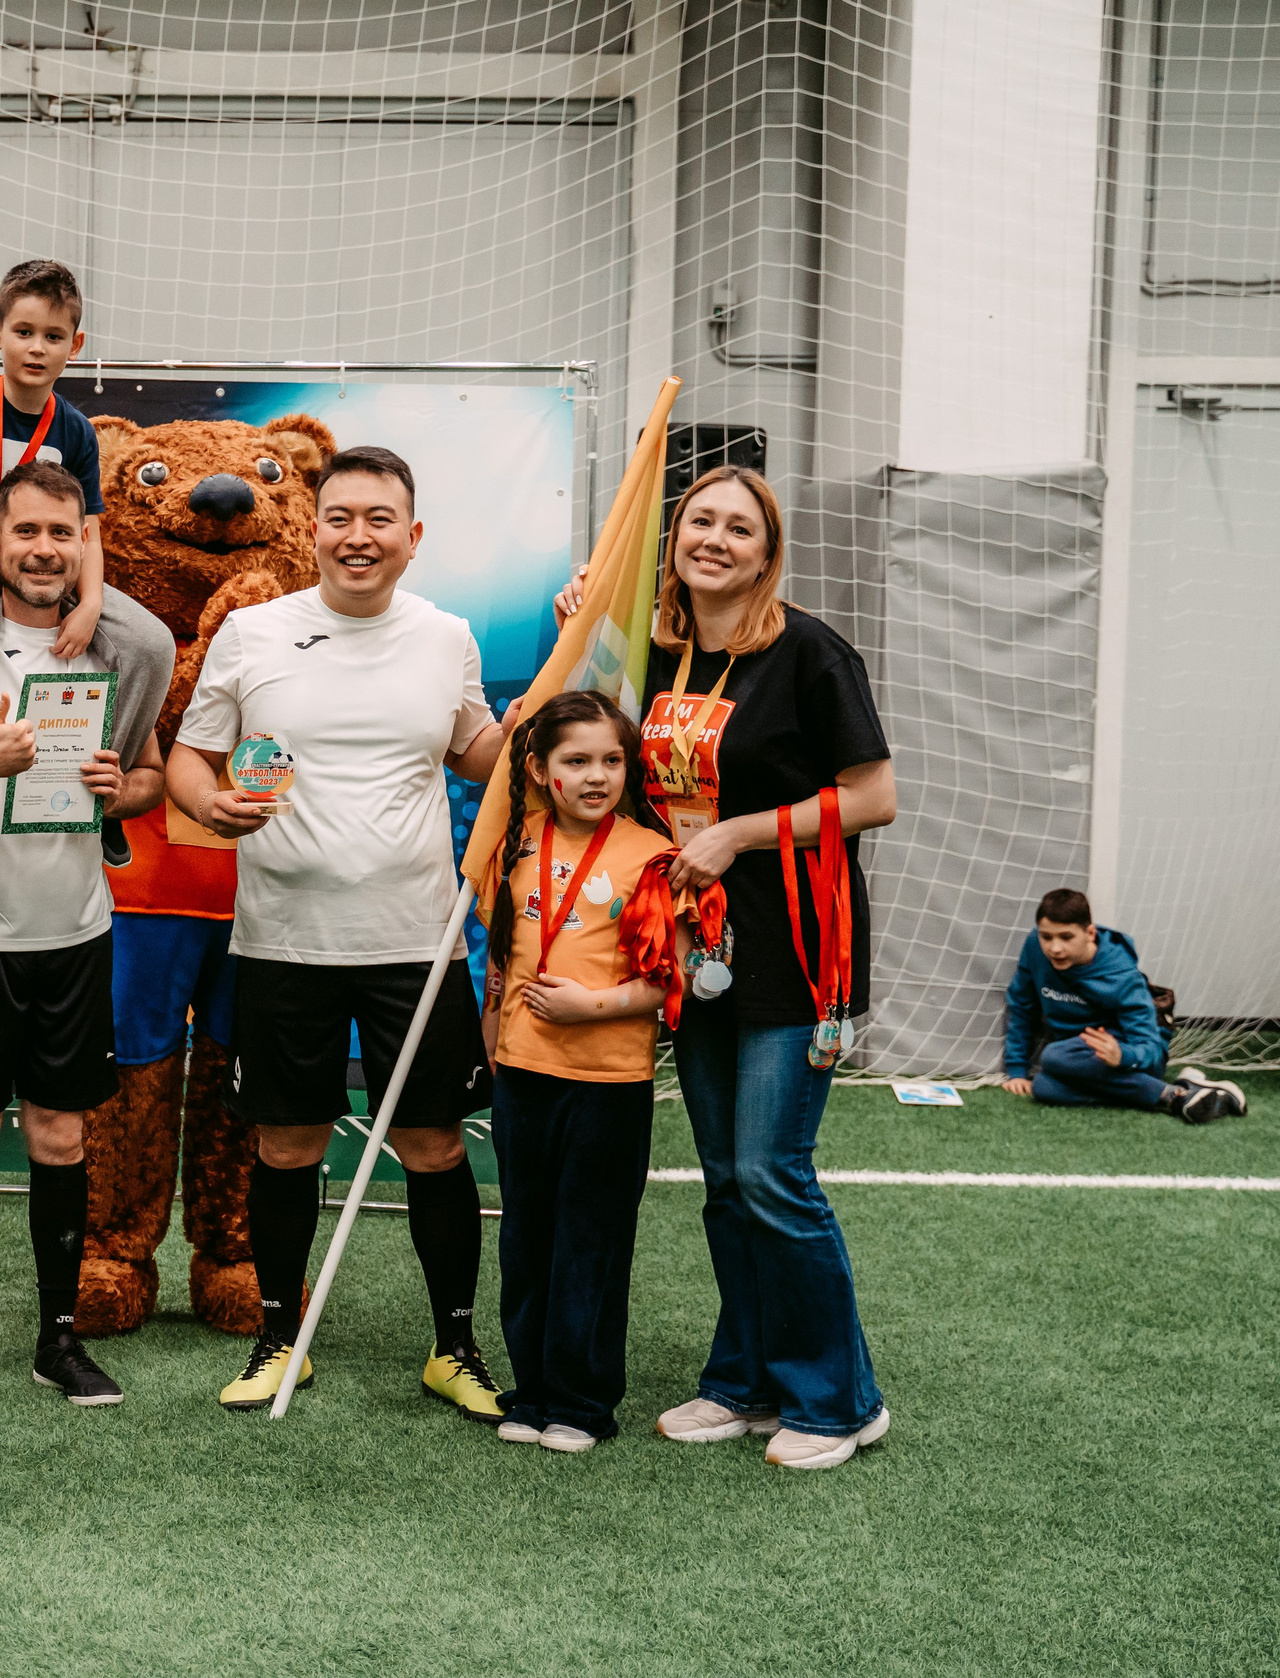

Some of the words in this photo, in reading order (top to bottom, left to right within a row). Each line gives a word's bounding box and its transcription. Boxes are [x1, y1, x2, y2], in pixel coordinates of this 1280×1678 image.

[37, 718, 89, 730] ДИПЛОМ
[237, 769, 269, 777] ФУТБОЛ
[271, 769, 289, 777] ПАП
[258, 778, 279, 786] 2023
